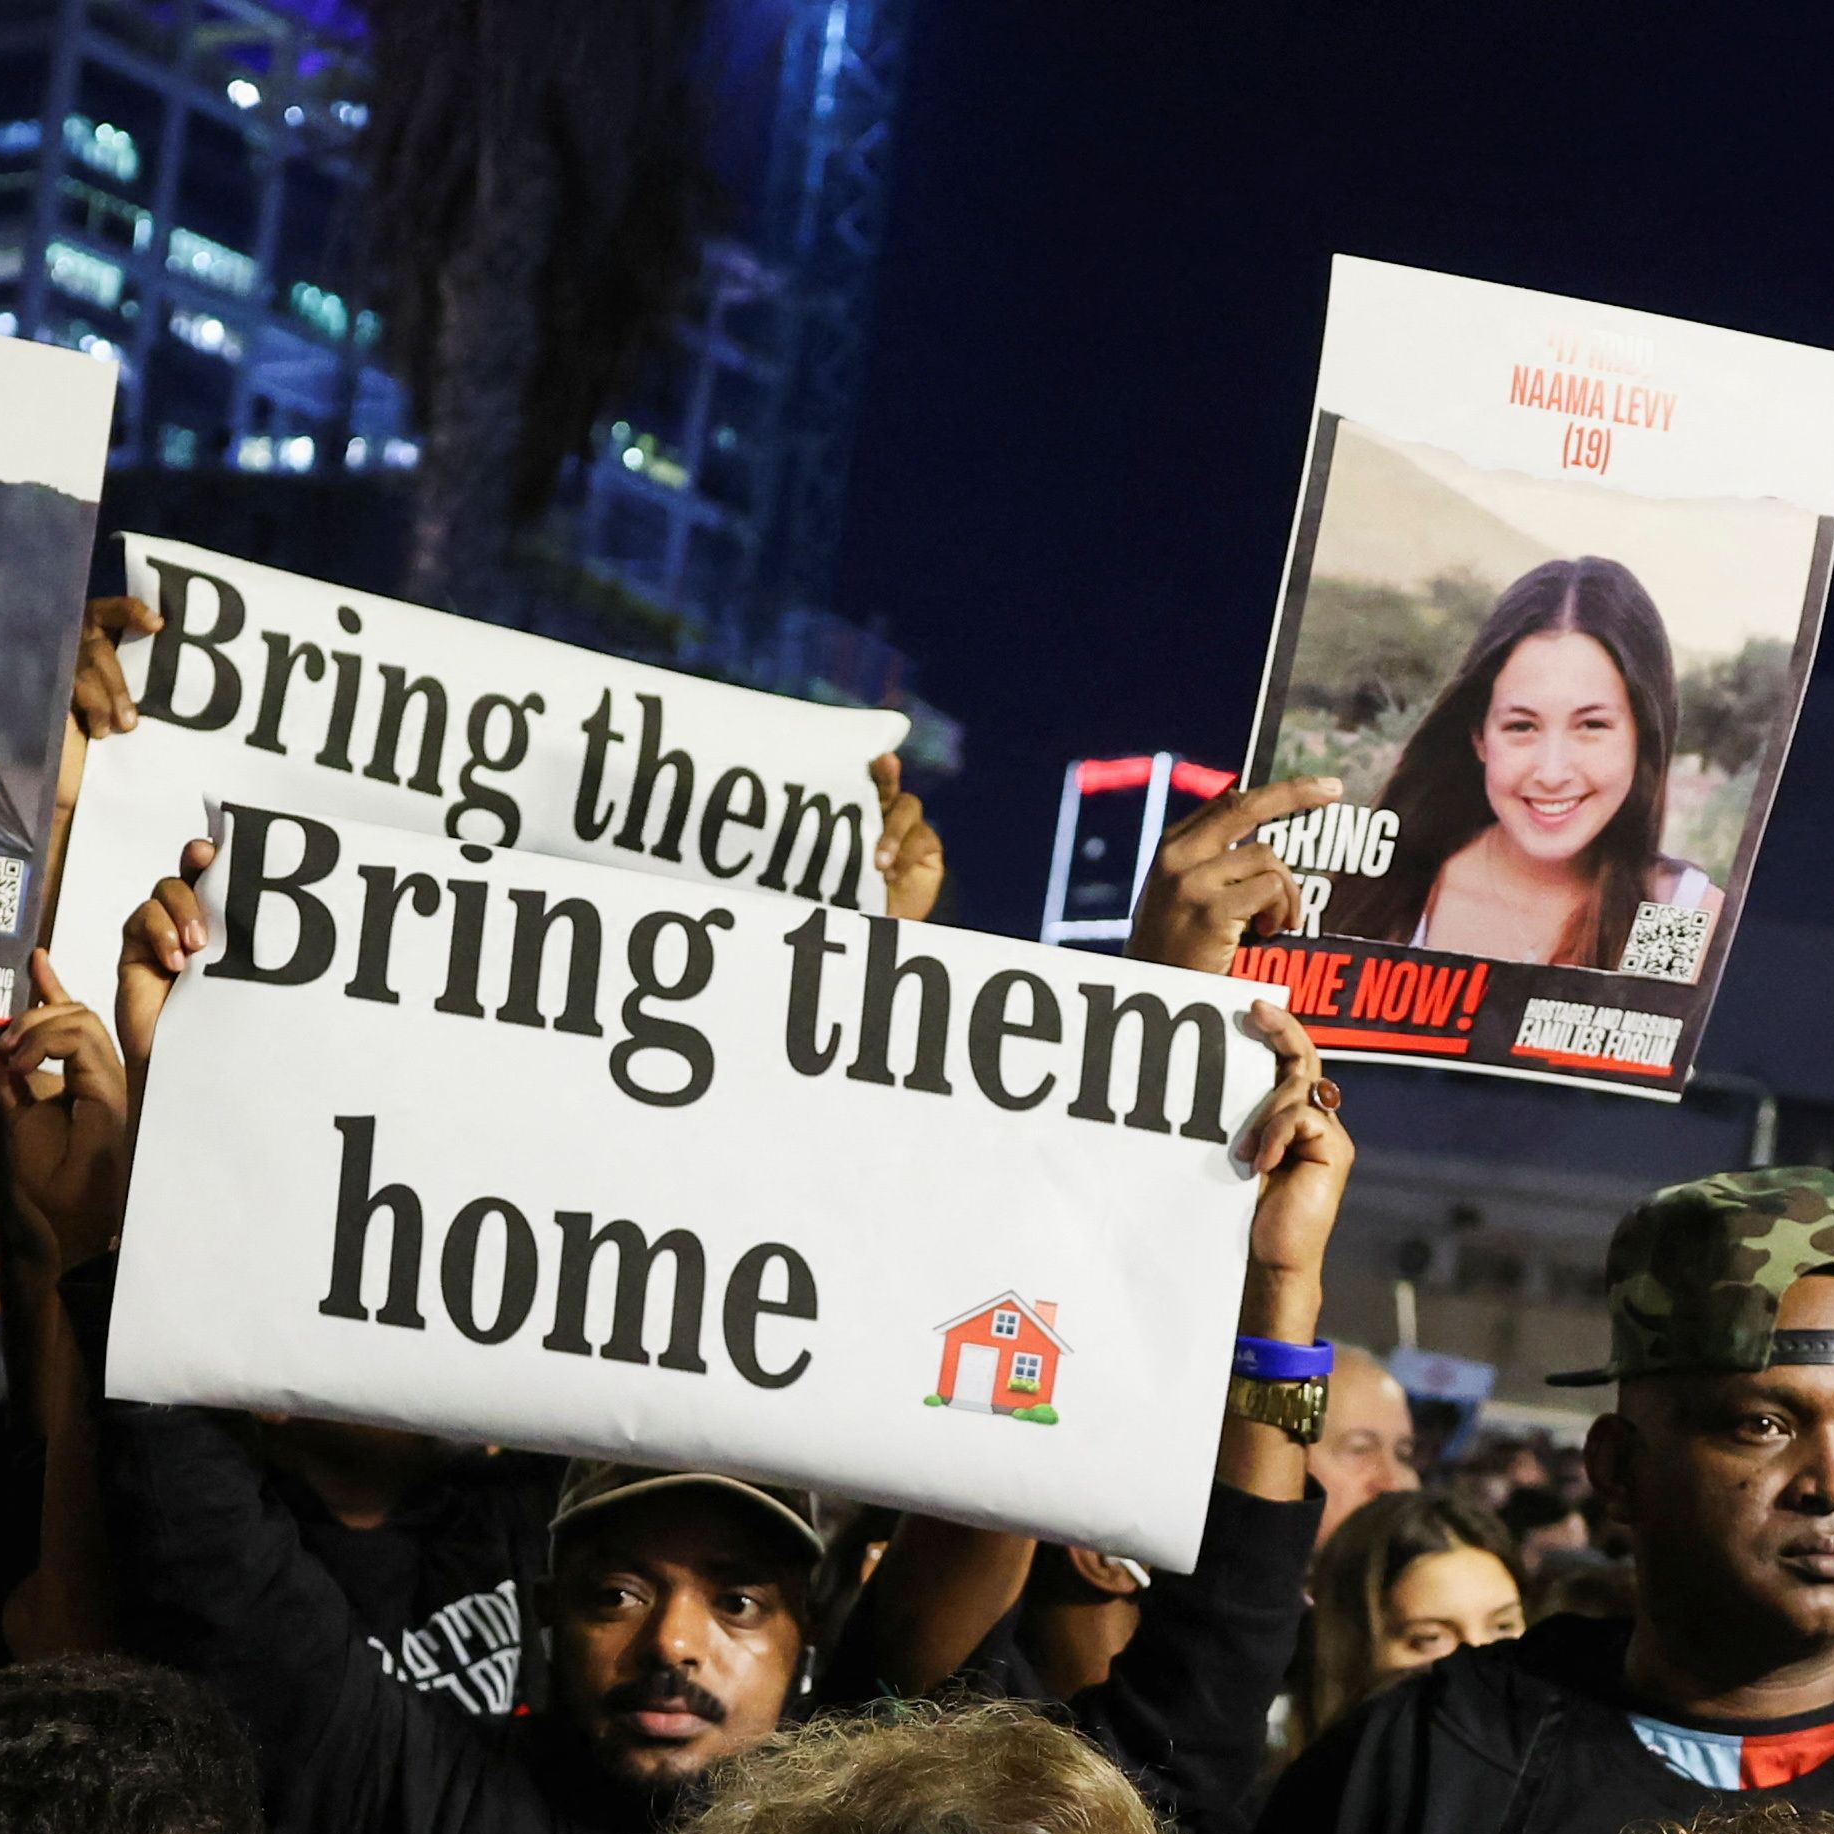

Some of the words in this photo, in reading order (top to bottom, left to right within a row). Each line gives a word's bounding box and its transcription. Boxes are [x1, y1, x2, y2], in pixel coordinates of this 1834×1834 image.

[1509, 363, 1606, 421] NAAMA
[1612, 382, 1679, 433] LEVY
[1562, 421, 1613, 476] (19)
[139, 555, 546, 849] Bring
[573, 685, 865, 911] them
[203, 800, 736, 1108] Bring
[783, 907, 1231, 1146] them
[1350, 956, 1491, 1032] NOW!
[1515, 1017, 1607, 1058] FAMILIES
[1602, 1028, 1680, 1069] FORUM
[1592, 1006, 1625, 1031] AND
[317, 1115, 820, 1389] home
